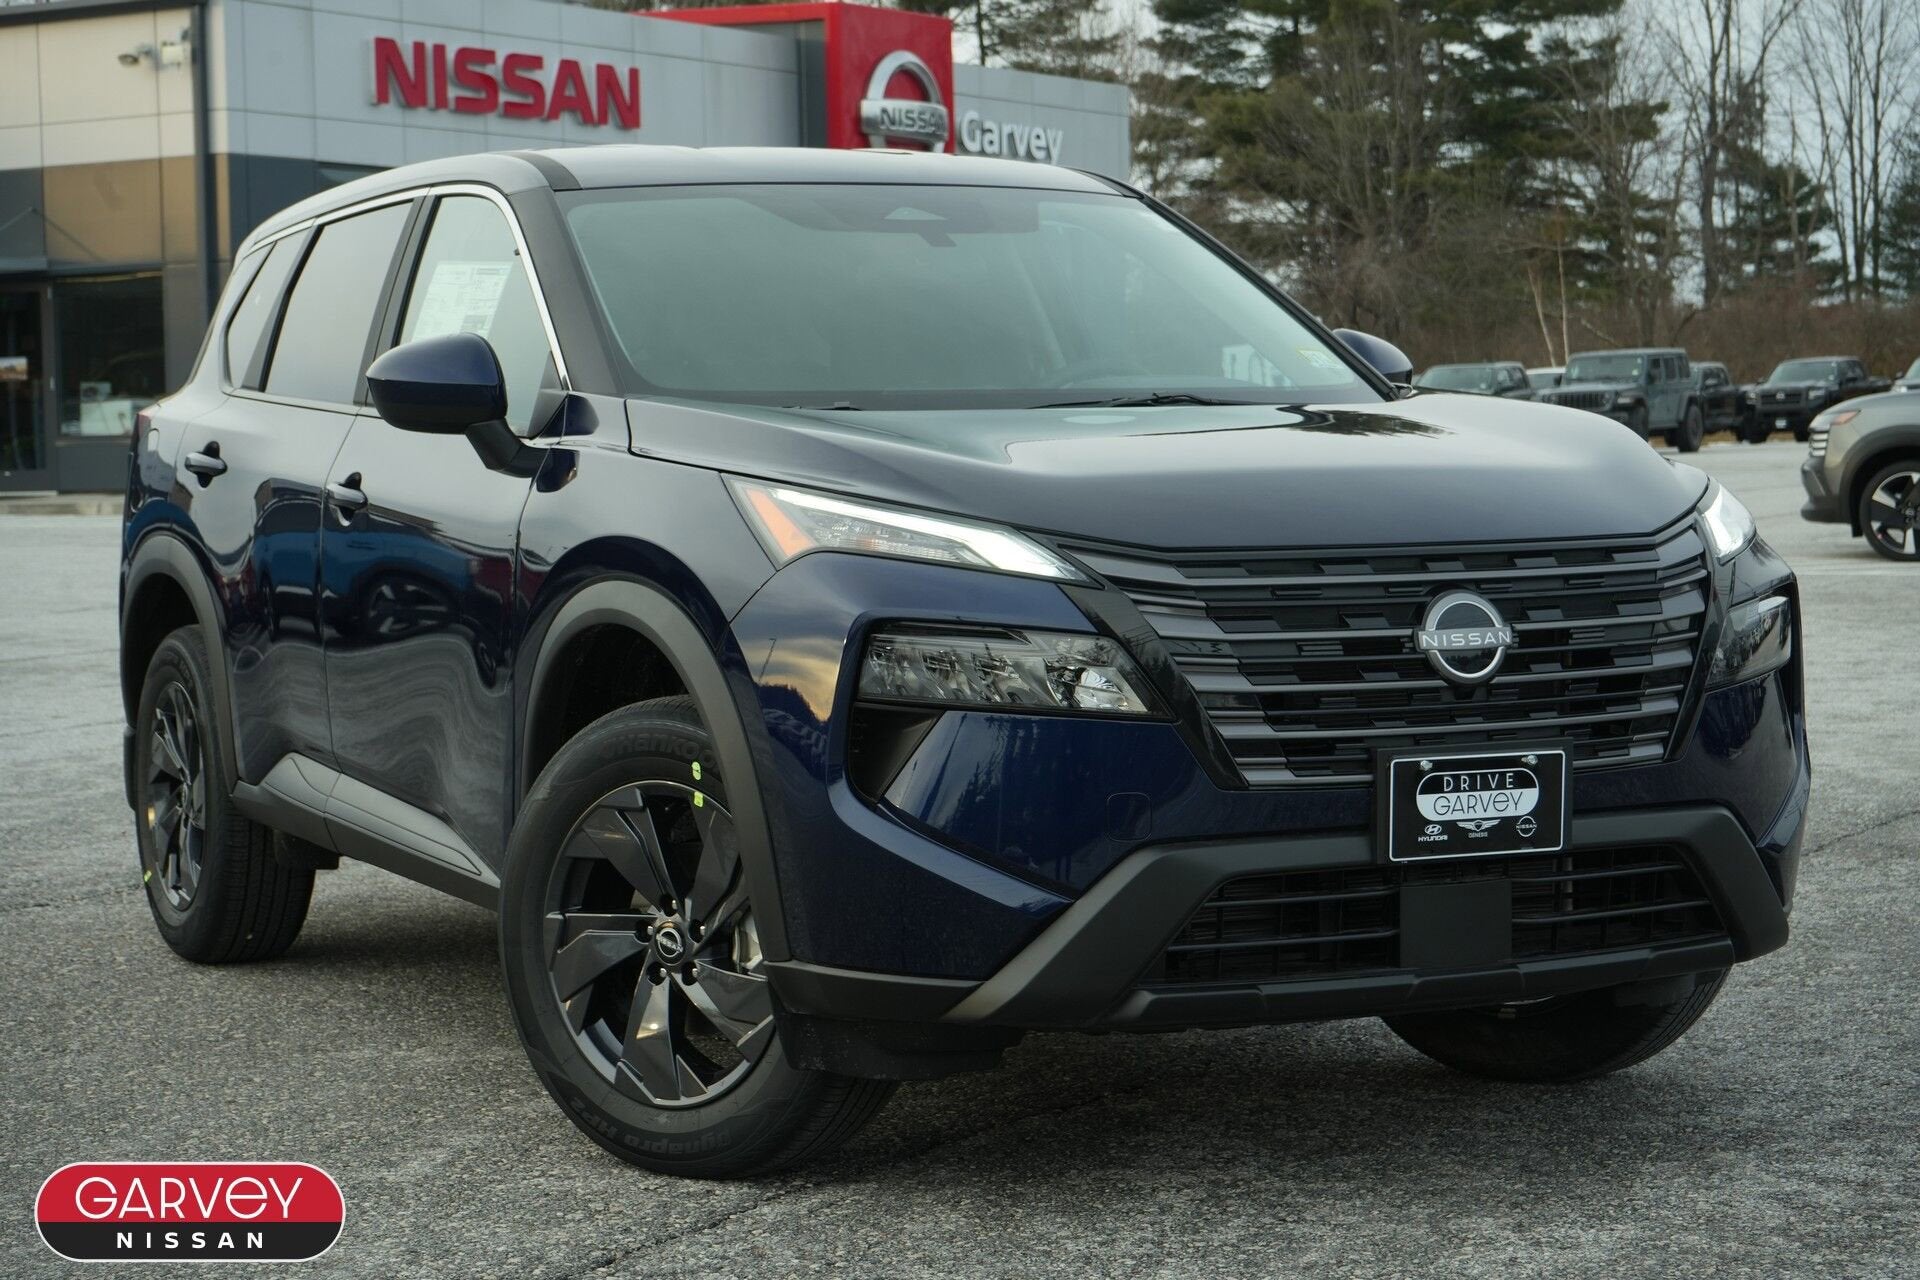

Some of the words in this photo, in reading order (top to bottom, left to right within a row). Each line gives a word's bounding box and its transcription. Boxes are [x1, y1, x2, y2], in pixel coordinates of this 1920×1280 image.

[374, 36, 640, 129] NISSAN
[961, 111, 1063, 163] Garvey
[1421, 631, 1511, 648] NISSAN
[1443, 773, 1515, 792] DRIVE
